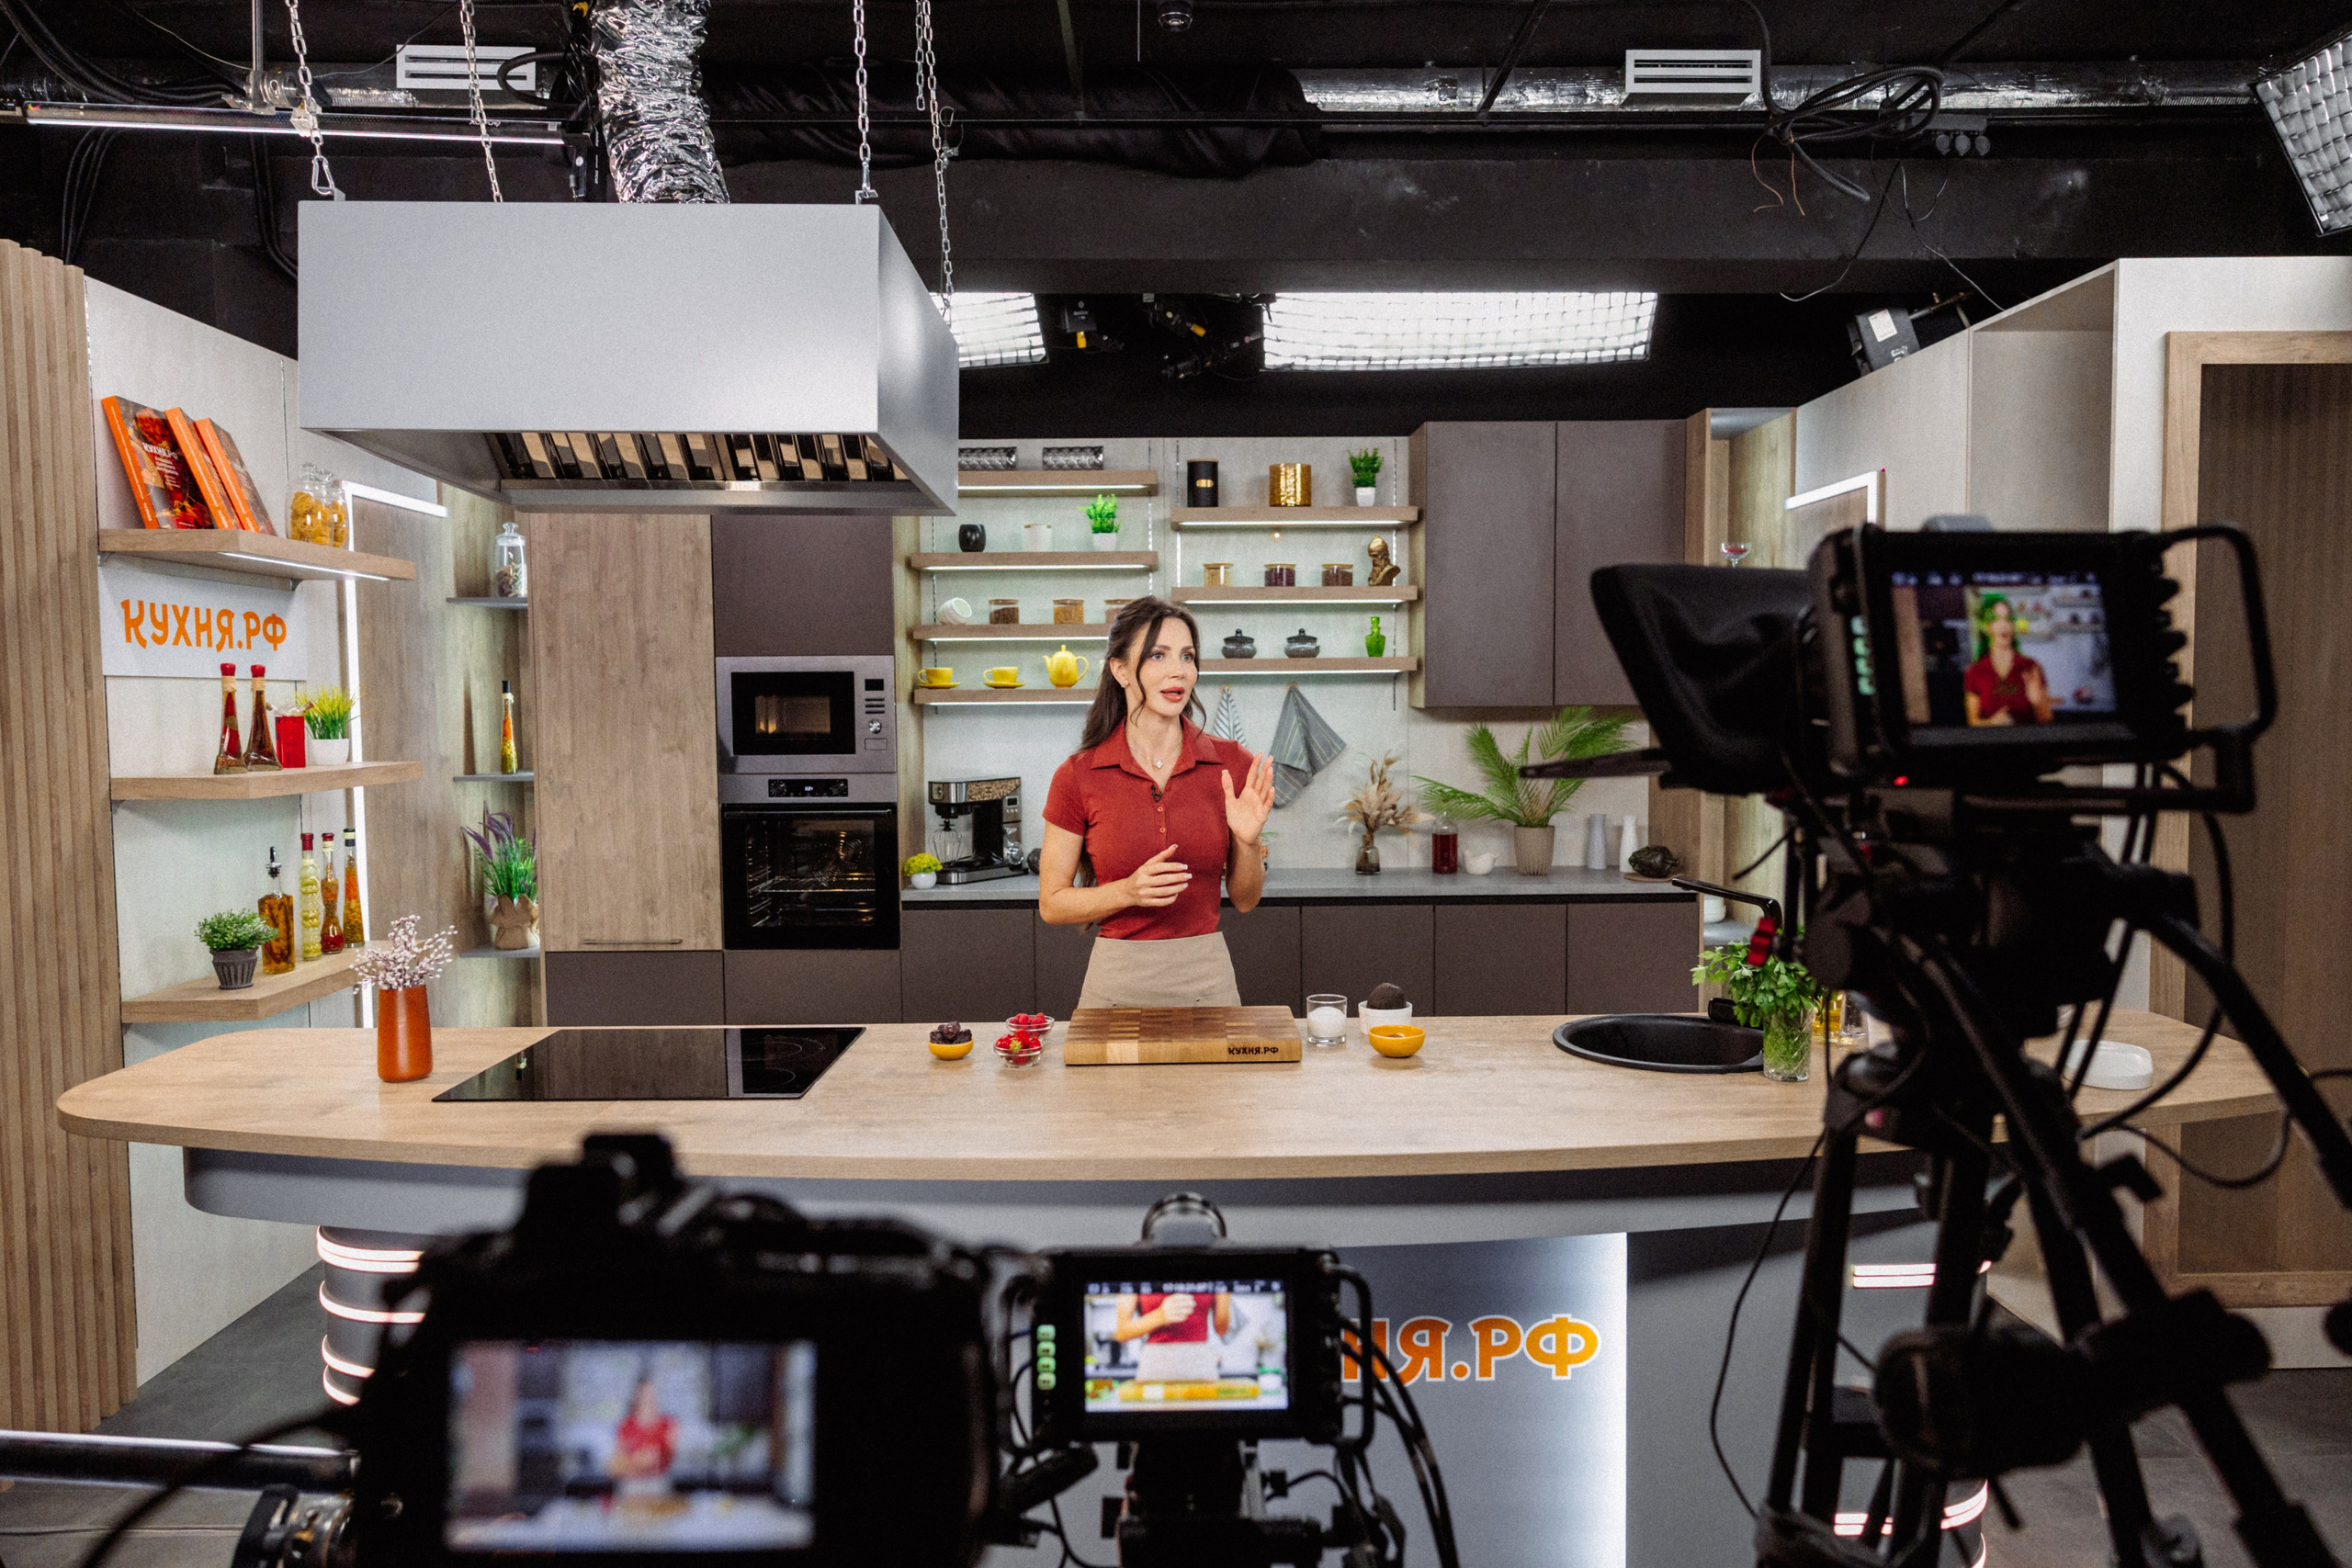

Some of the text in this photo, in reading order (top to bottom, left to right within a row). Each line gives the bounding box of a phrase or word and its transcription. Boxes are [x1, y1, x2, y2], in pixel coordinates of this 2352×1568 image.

[120, 599, 287, 653] КУХНЯ.РФ
[1227, 1046, 1279, 1055] КУХНЯ.РФ
[1341, 1314, 1601, 1386] НЯ.РФ
